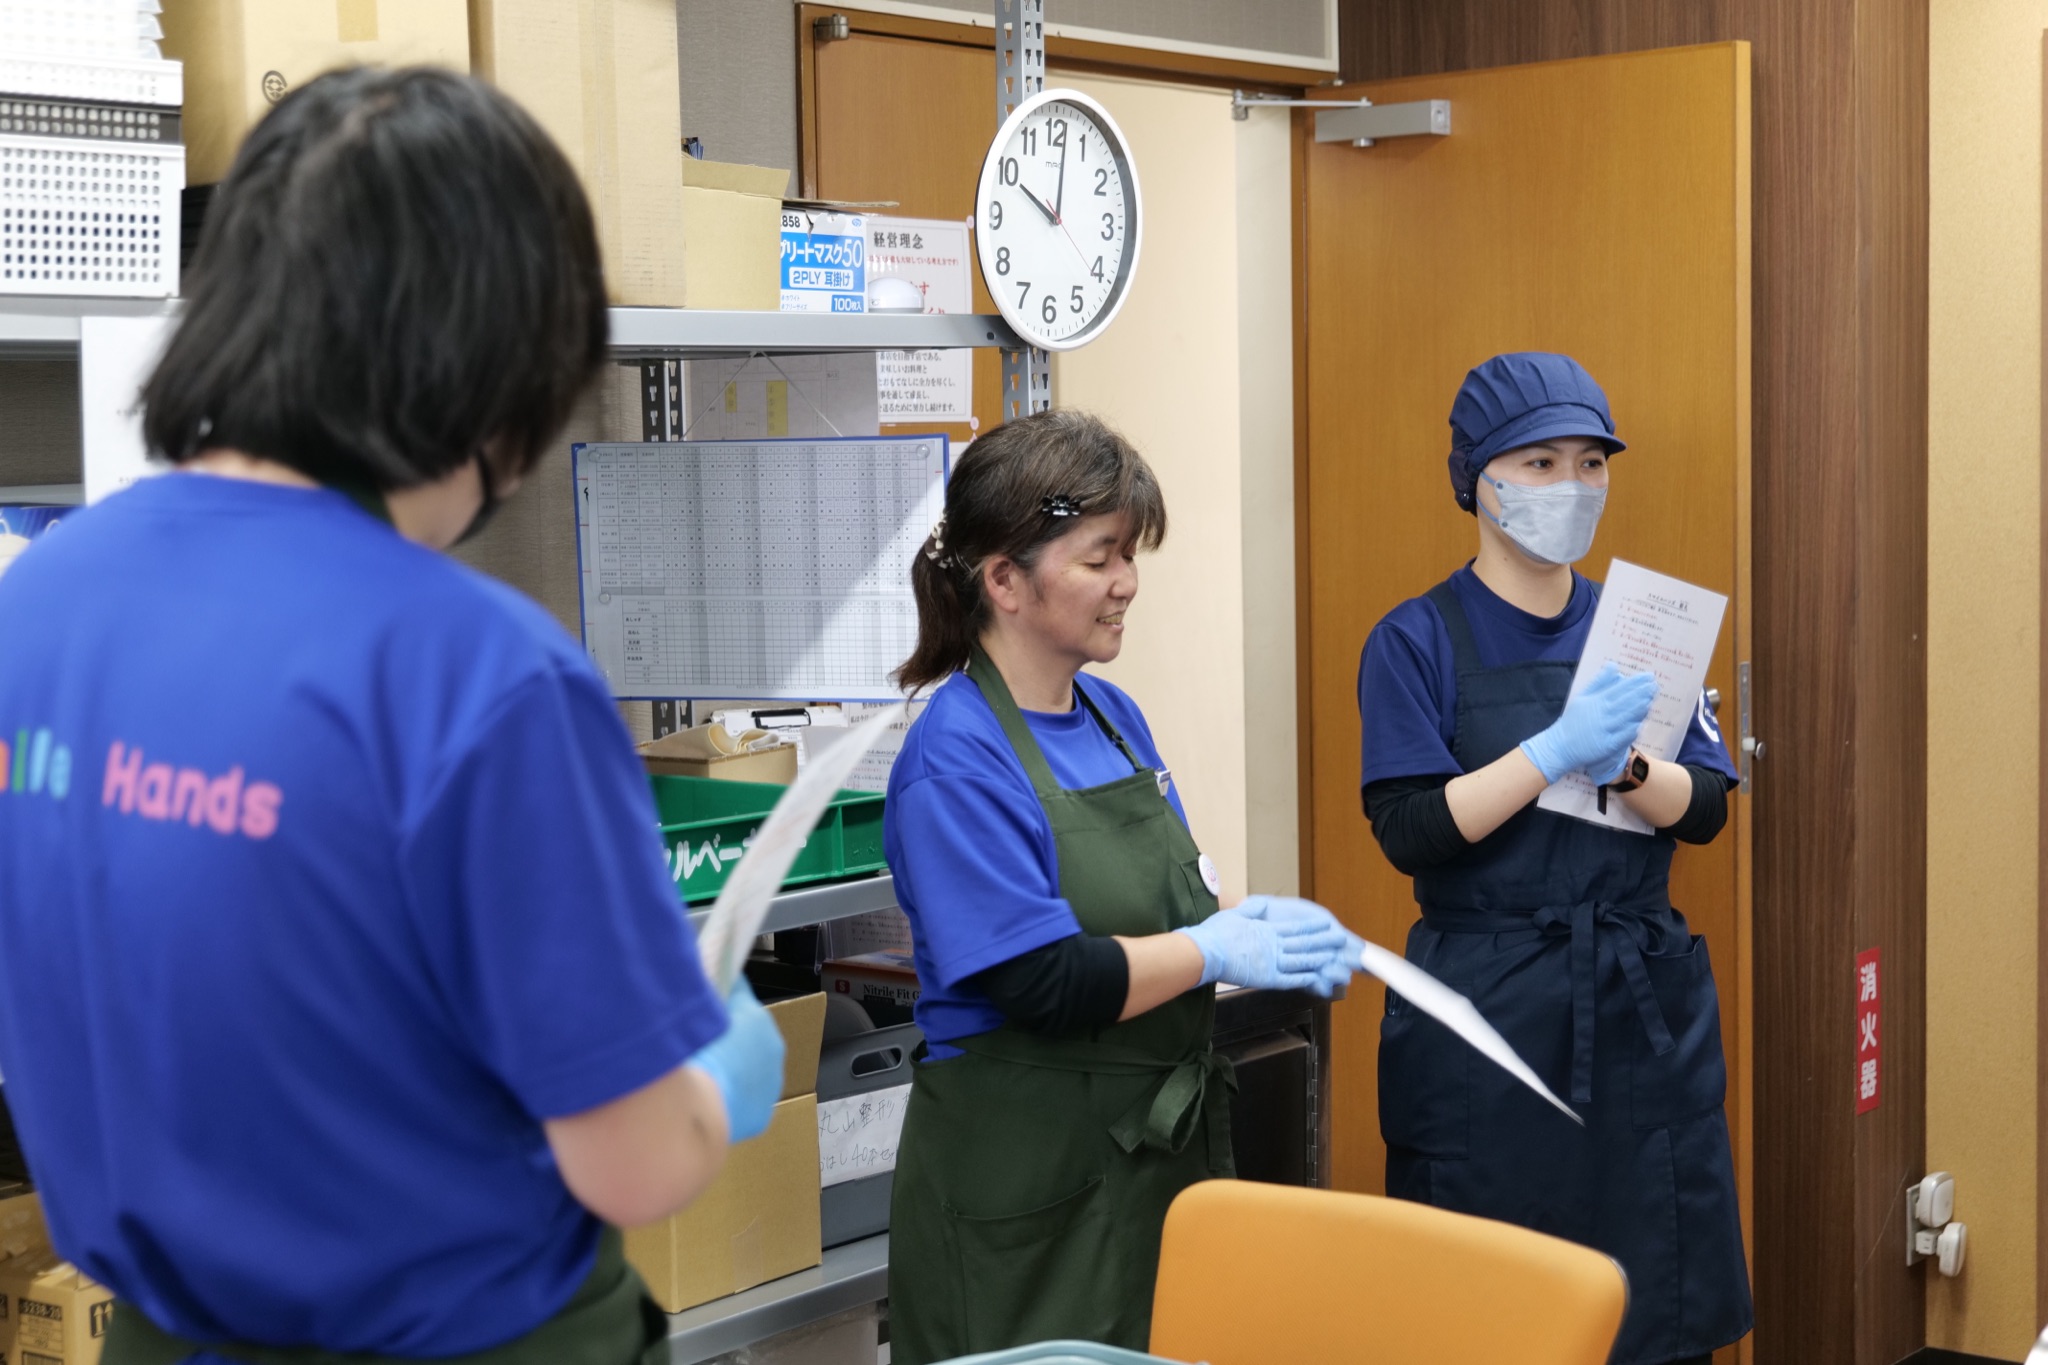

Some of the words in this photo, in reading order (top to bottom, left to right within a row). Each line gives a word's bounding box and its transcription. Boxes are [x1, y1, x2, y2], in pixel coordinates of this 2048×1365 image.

[1021, 127, 1036, 156] 11
[1046, 118, 1065, 147] 12
[1079, 134, 1086, 162] 1
[999, 156, 1019, 186] 10
[1094, 168, 1107, 196] 2
[989, 200, 1003, 230] 9
[1101, 213, 1114, 241] 3
[874, 231, 924, 249] 経営理念
[996, 246, 1010, 276] 8
[1091, 255, 1104, 283] 4
[793, 272, 821, 284] 2PLY
[825, 272, 850, 287] 耳掛け
[834, 298, 862, 311] 100枚入
[1016, 282, 1031, 309] 7
[1042, 295, 1057, 324] 6
[1070, 286, 1084, 314] 5
[880, 403, 956, 412] 送るために努力し続けます。
[103, 740, 284, 839] Hands
[863, 984, 894, 998] Nitrile
[896, 989, 910, 1000] Fit
[912, 991, 921, 1000] G
[1860, 961, 1877, 1100] 消火器
